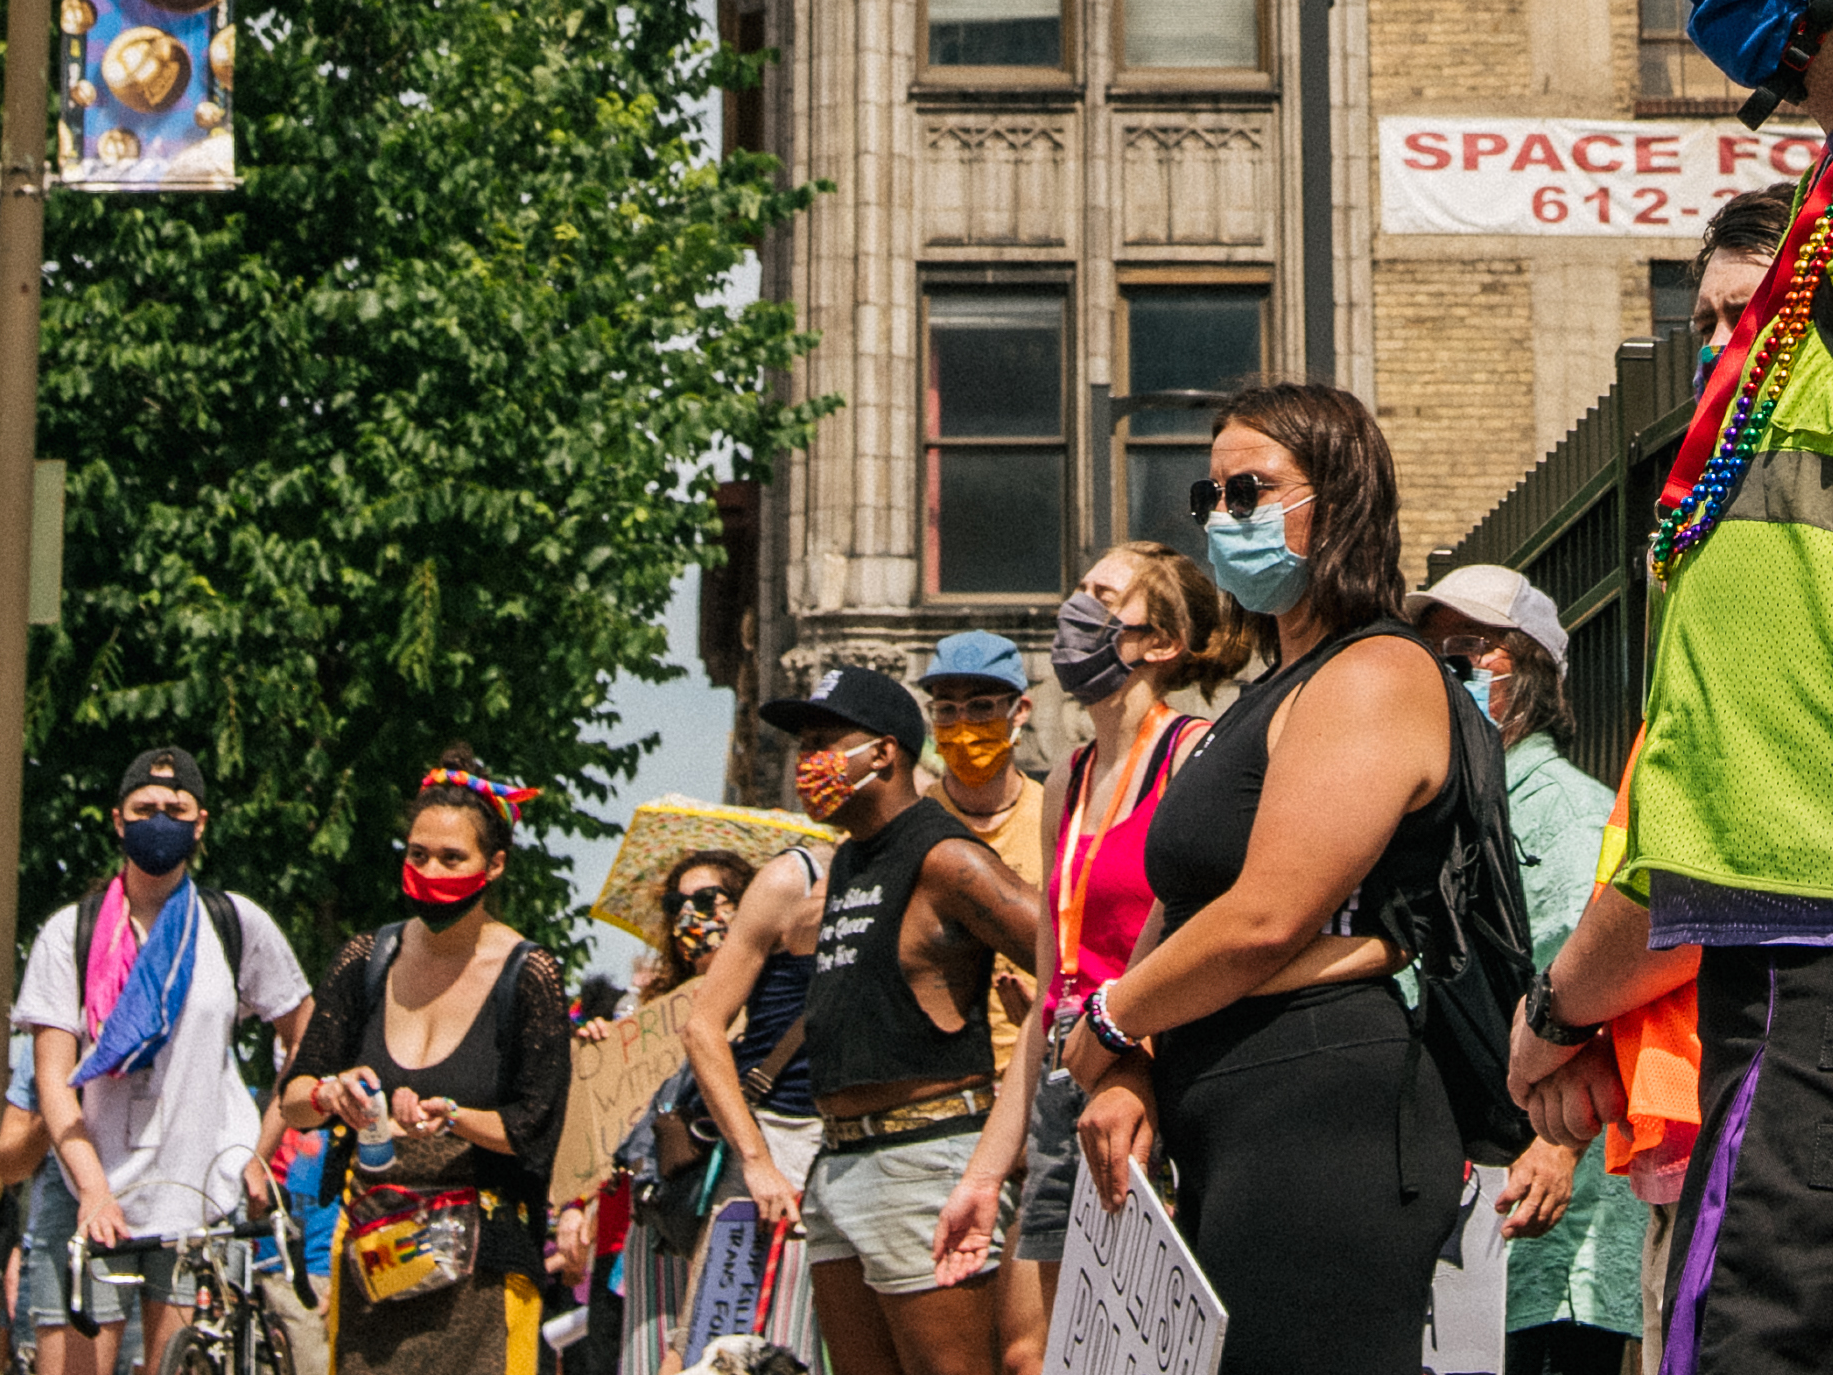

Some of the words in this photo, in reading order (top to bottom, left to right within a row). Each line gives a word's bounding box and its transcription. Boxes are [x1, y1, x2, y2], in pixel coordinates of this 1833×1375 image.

[1402, 131, 1682, 176] SPACE
[1717, 135, 1821, 177] FO
[617, 993, 699, 1064] PRID
